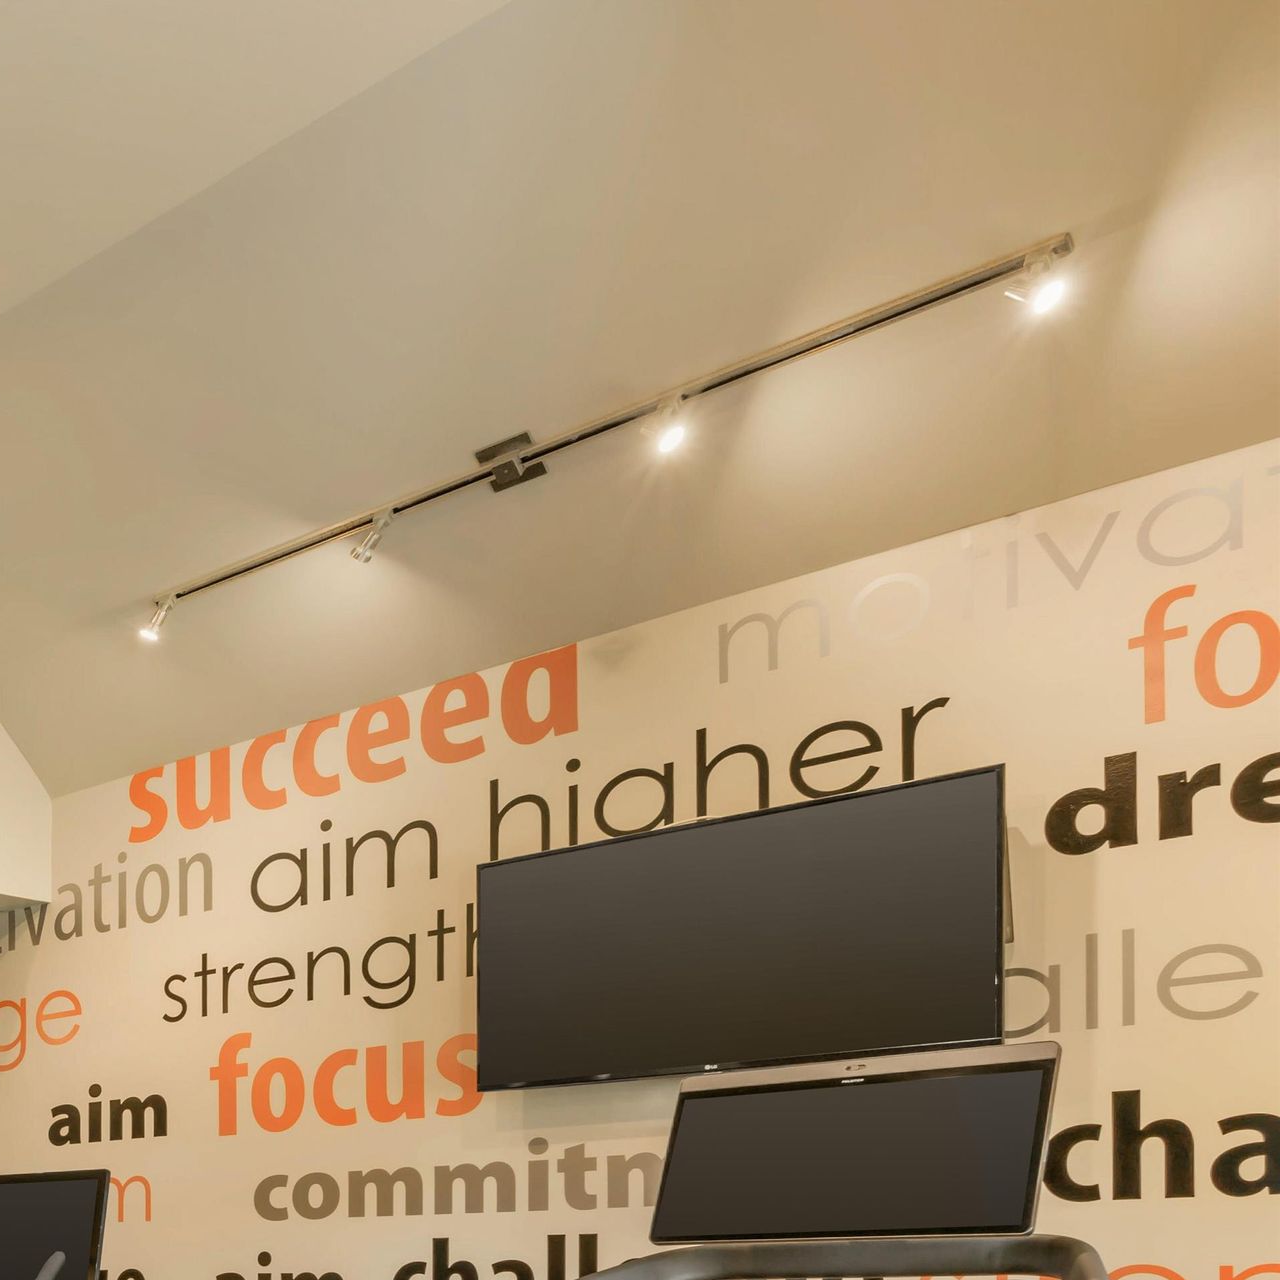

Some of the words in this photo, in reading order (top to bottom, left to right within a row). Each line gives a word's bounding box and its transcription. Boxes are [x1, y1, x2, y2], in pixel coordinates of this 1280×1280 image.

[128, 643, 578, 843] succeed
[250, 819, 438, 913] aim
[48, 1083, 168, 1147] aim
[210, 1033, 484, 1138] focus
